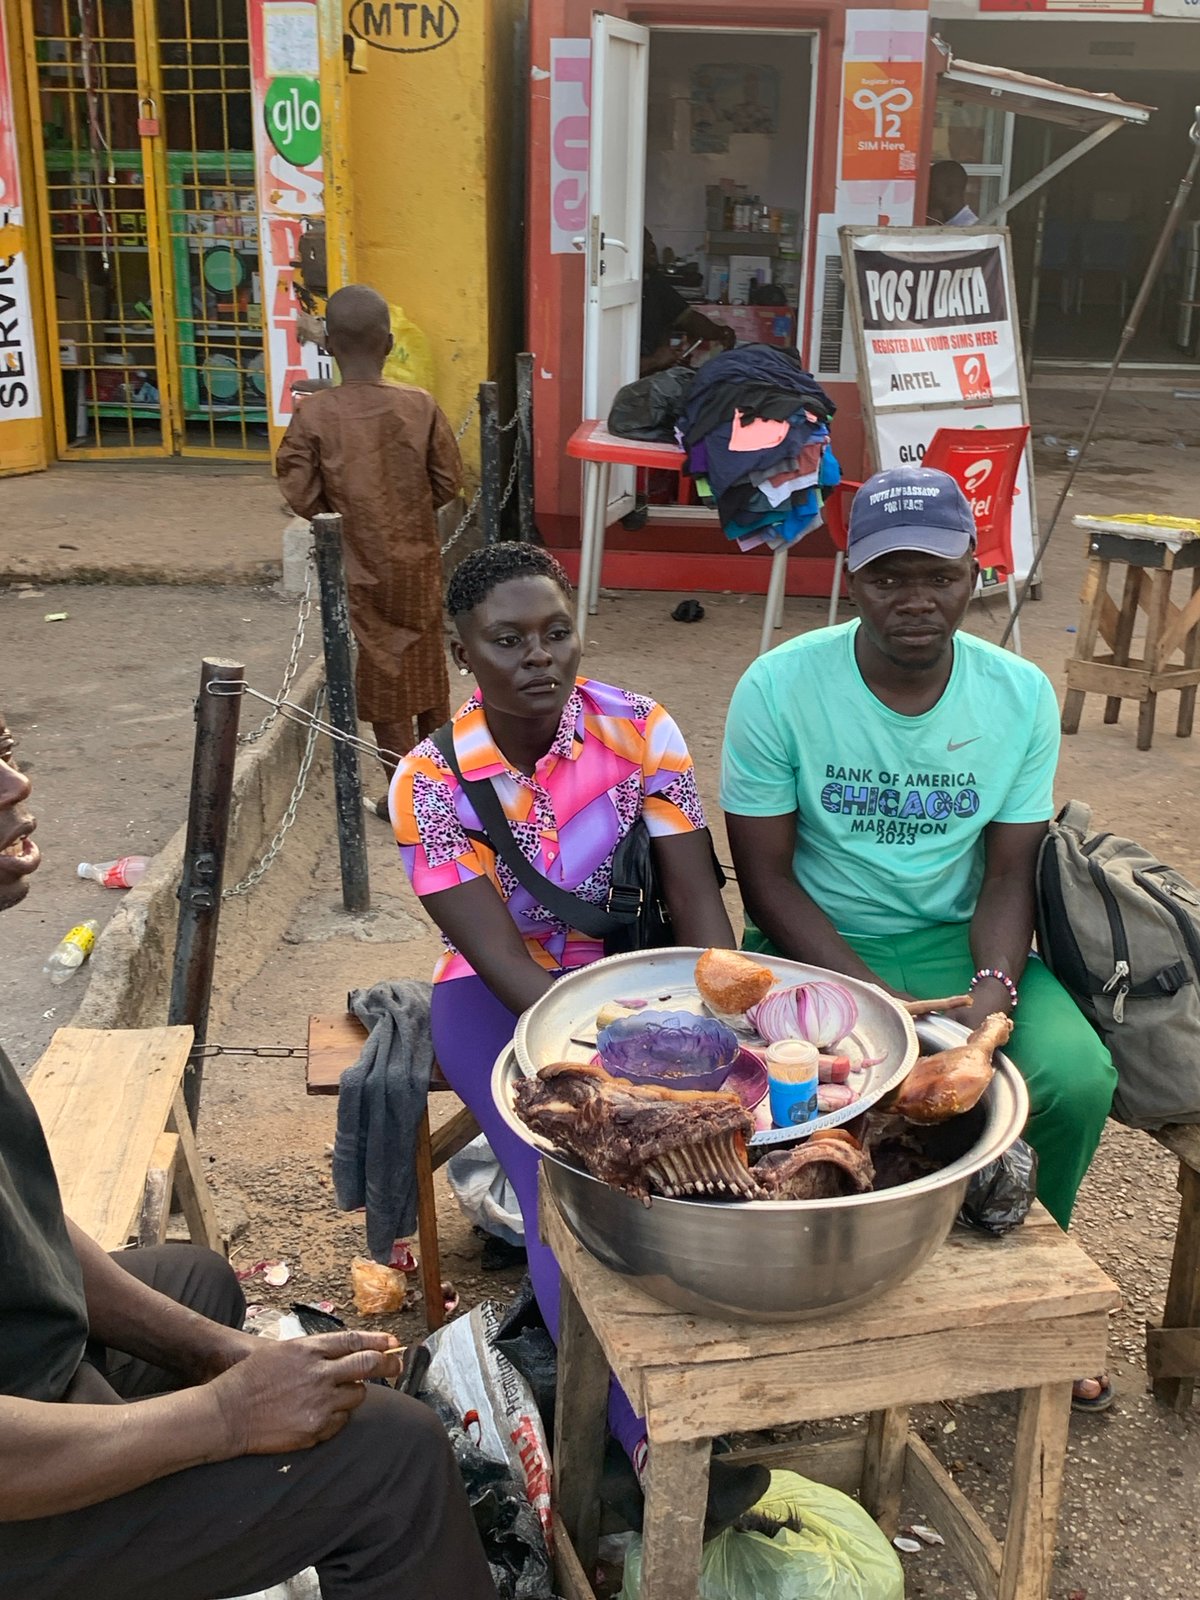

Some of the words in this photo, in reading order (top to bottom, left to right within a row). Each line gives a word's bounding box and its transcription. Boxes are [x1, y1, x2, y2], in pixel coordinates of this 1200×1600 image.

[363, 2, 444, 39] MTN
[272, 88, 321, 145] glo
[858, 141, 878, 151] SIM
[881, 141, 906, 151] Here
[865, 270, 914, 322] POS
[914, 270, 935, 321] N
[934, 266, 991, 319] DATA
[871, 339, 910, 354] REGISTER
[910, 338, 925, 352] ALL
[925, 335, 950, 352] YOUR
[950, 333, 974, 349] SIMS
[975, 331, 998, 346] HERE
[890, 371, 941, 391] AIRTEL
[899, 443, 926, 463] GLO
[869, 488, 890, 505] YOUTH
[970, 495, 992, 517] tel
[825, 765, 873, 783] BANK
[878, 771, 900, 786] OF
[904, 772, 976, 787] AMERICA
[821, 782, 980, 821] CHICAGO
[851, 819, 948, 835] MARATHON
[875, 832, 916, 846] 2023
